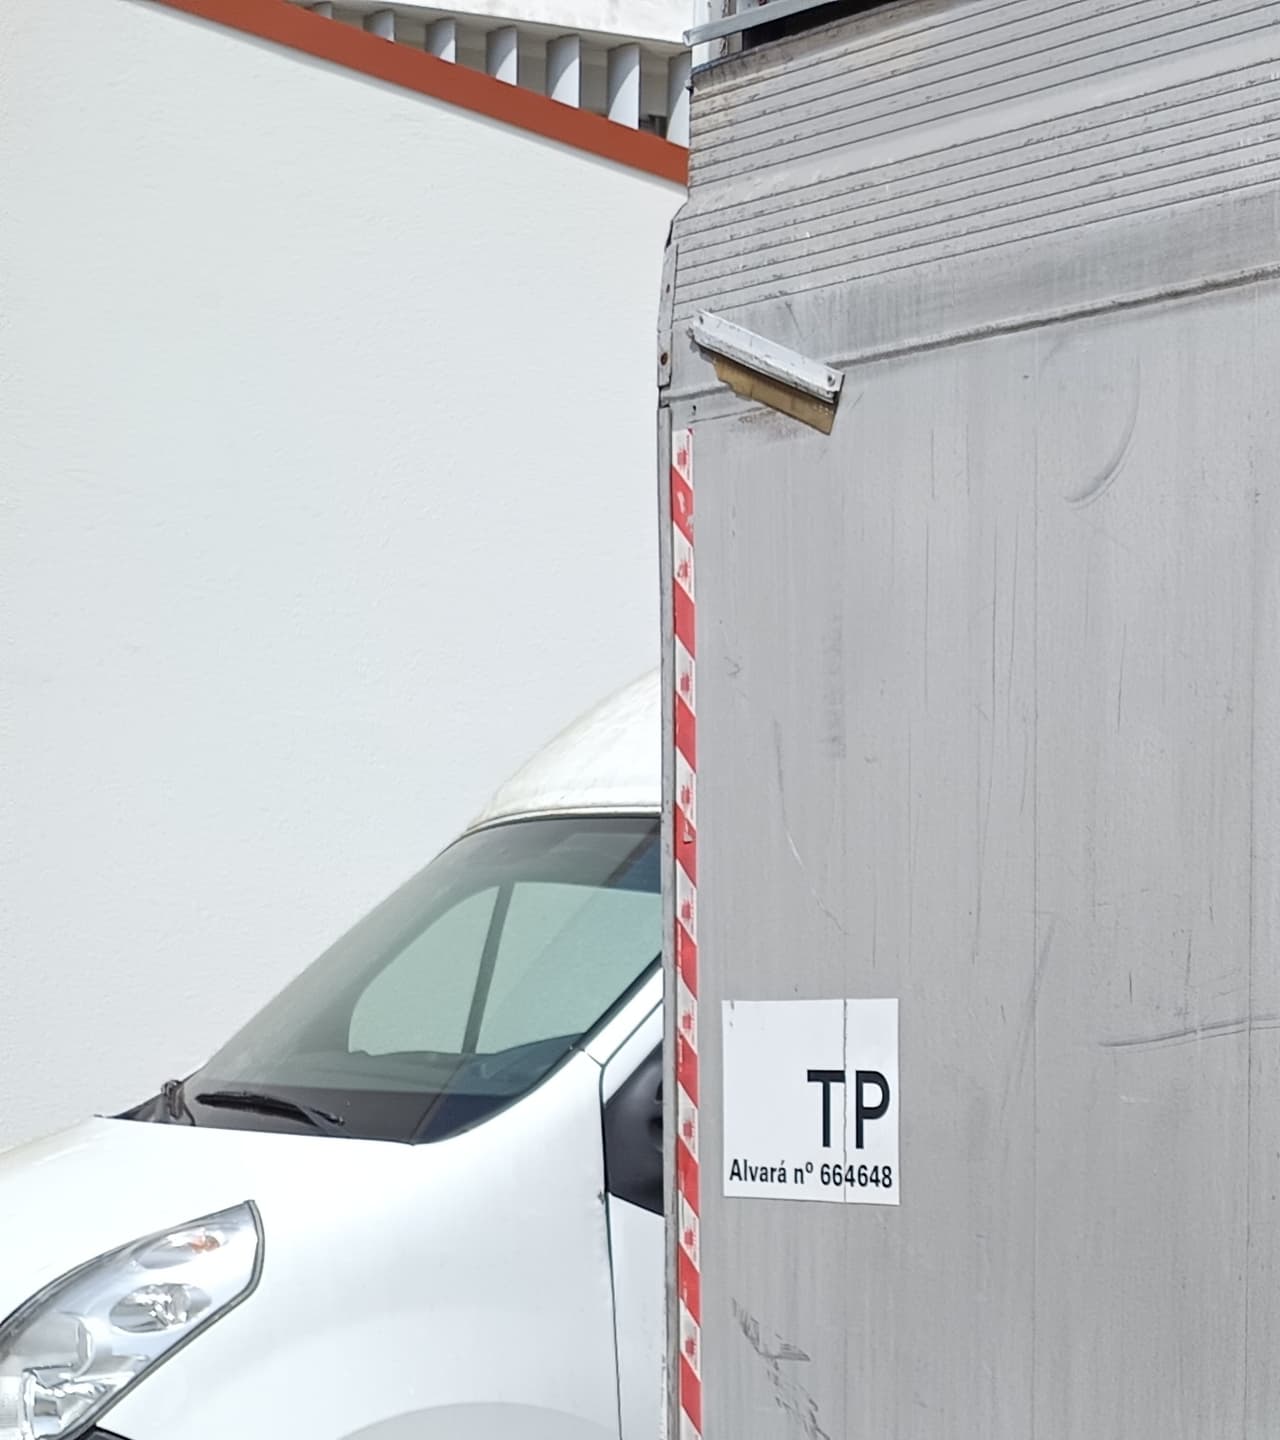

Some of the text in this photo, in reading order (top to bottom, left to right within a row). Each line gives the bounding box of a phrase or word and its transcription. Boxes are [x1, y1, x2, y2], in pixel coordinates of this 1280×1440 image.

[807, 1069, 890, 1149] TP
[730, 1159, 787, 1184] Alvará
[820, 1164, 892, 1188] 664648
